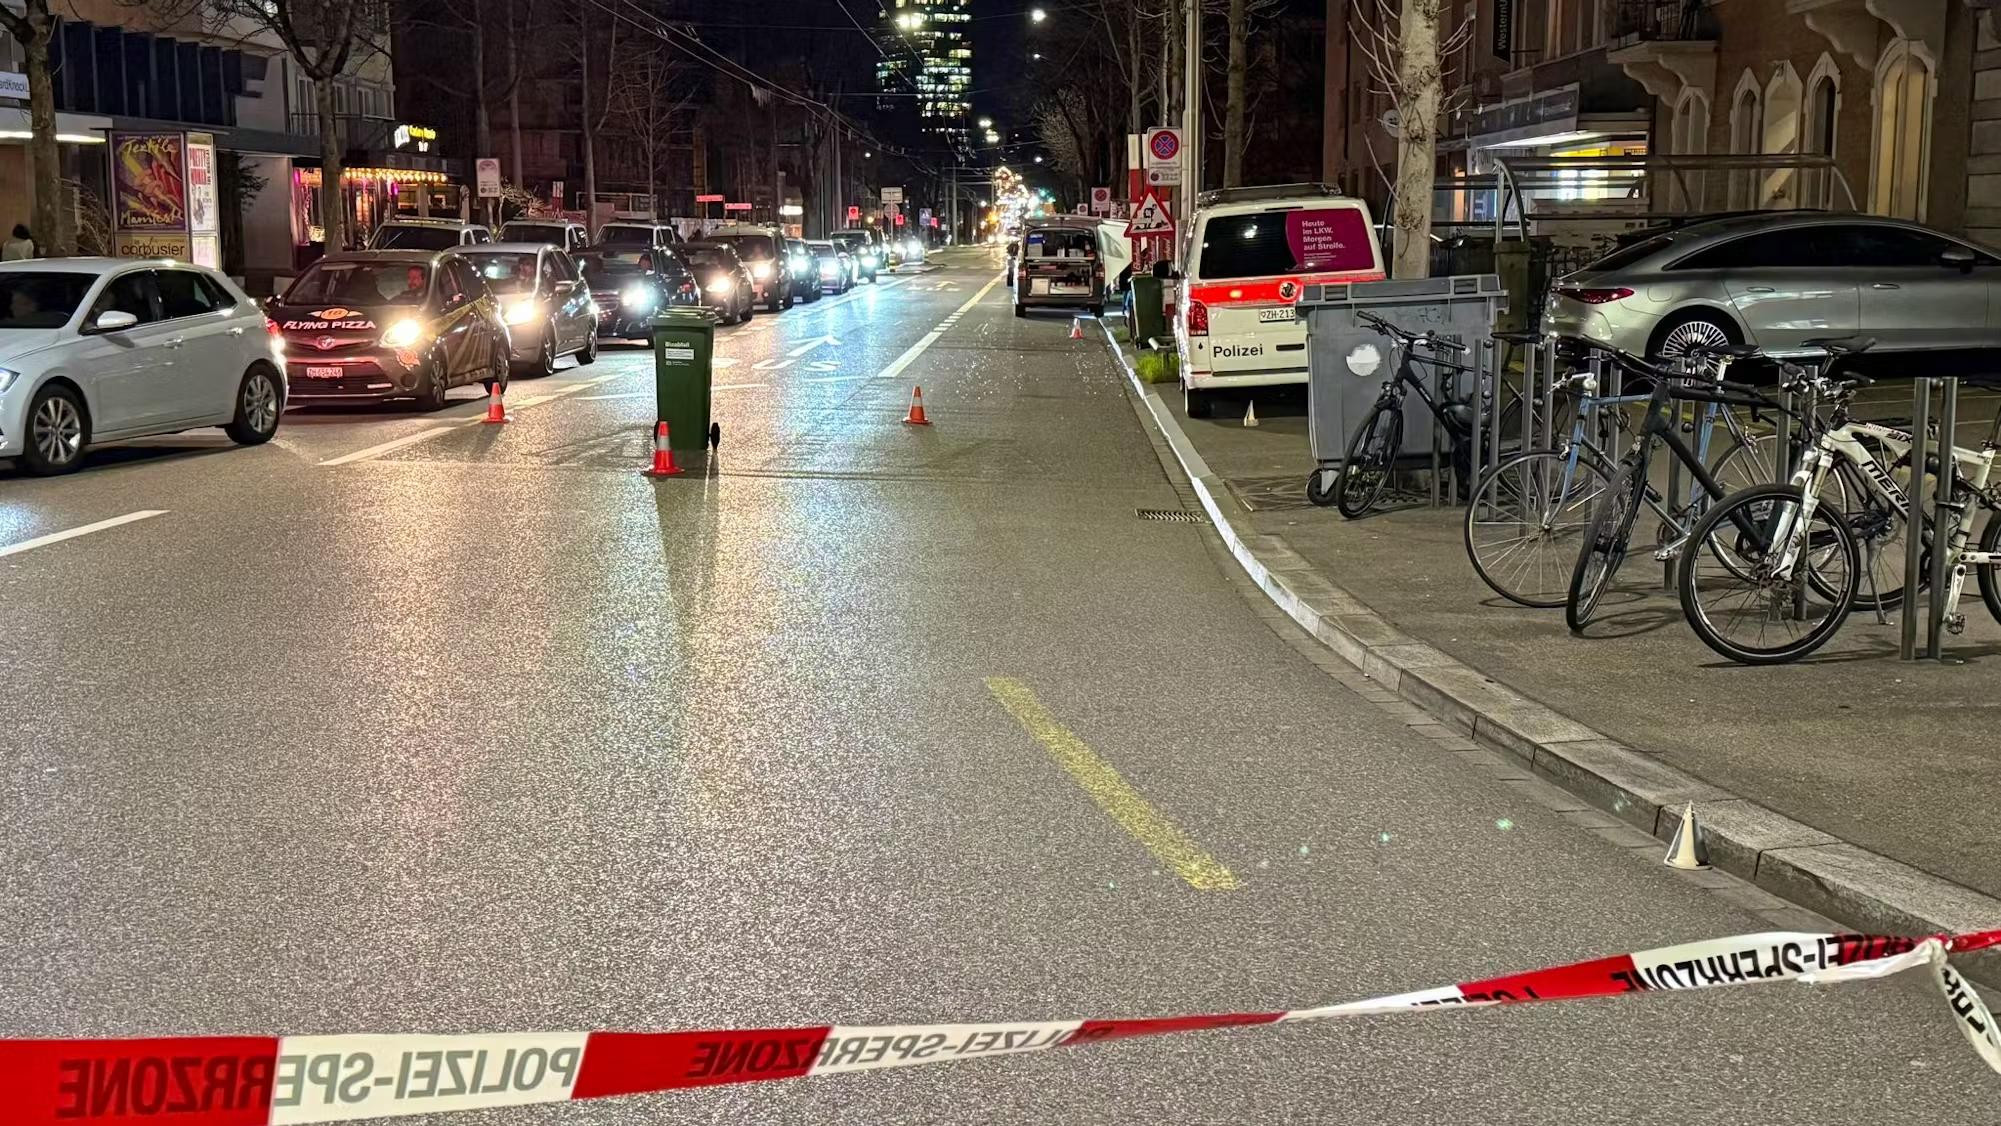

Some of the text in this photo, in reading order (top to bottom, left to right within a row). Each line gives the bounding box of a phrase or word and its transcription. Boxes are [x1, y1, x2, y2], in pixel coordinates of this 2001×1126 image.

[1302, 220, 1325, 228] Heute
[1303, 235, 1332, 244] Morgen
[121, 242, 186, 256] corbusier
[283, 320, 376, 330] FLYING PIZZA
[1213, 343, 1264, 358] Polizei
[1861, 460, 1911, 513] MERI
